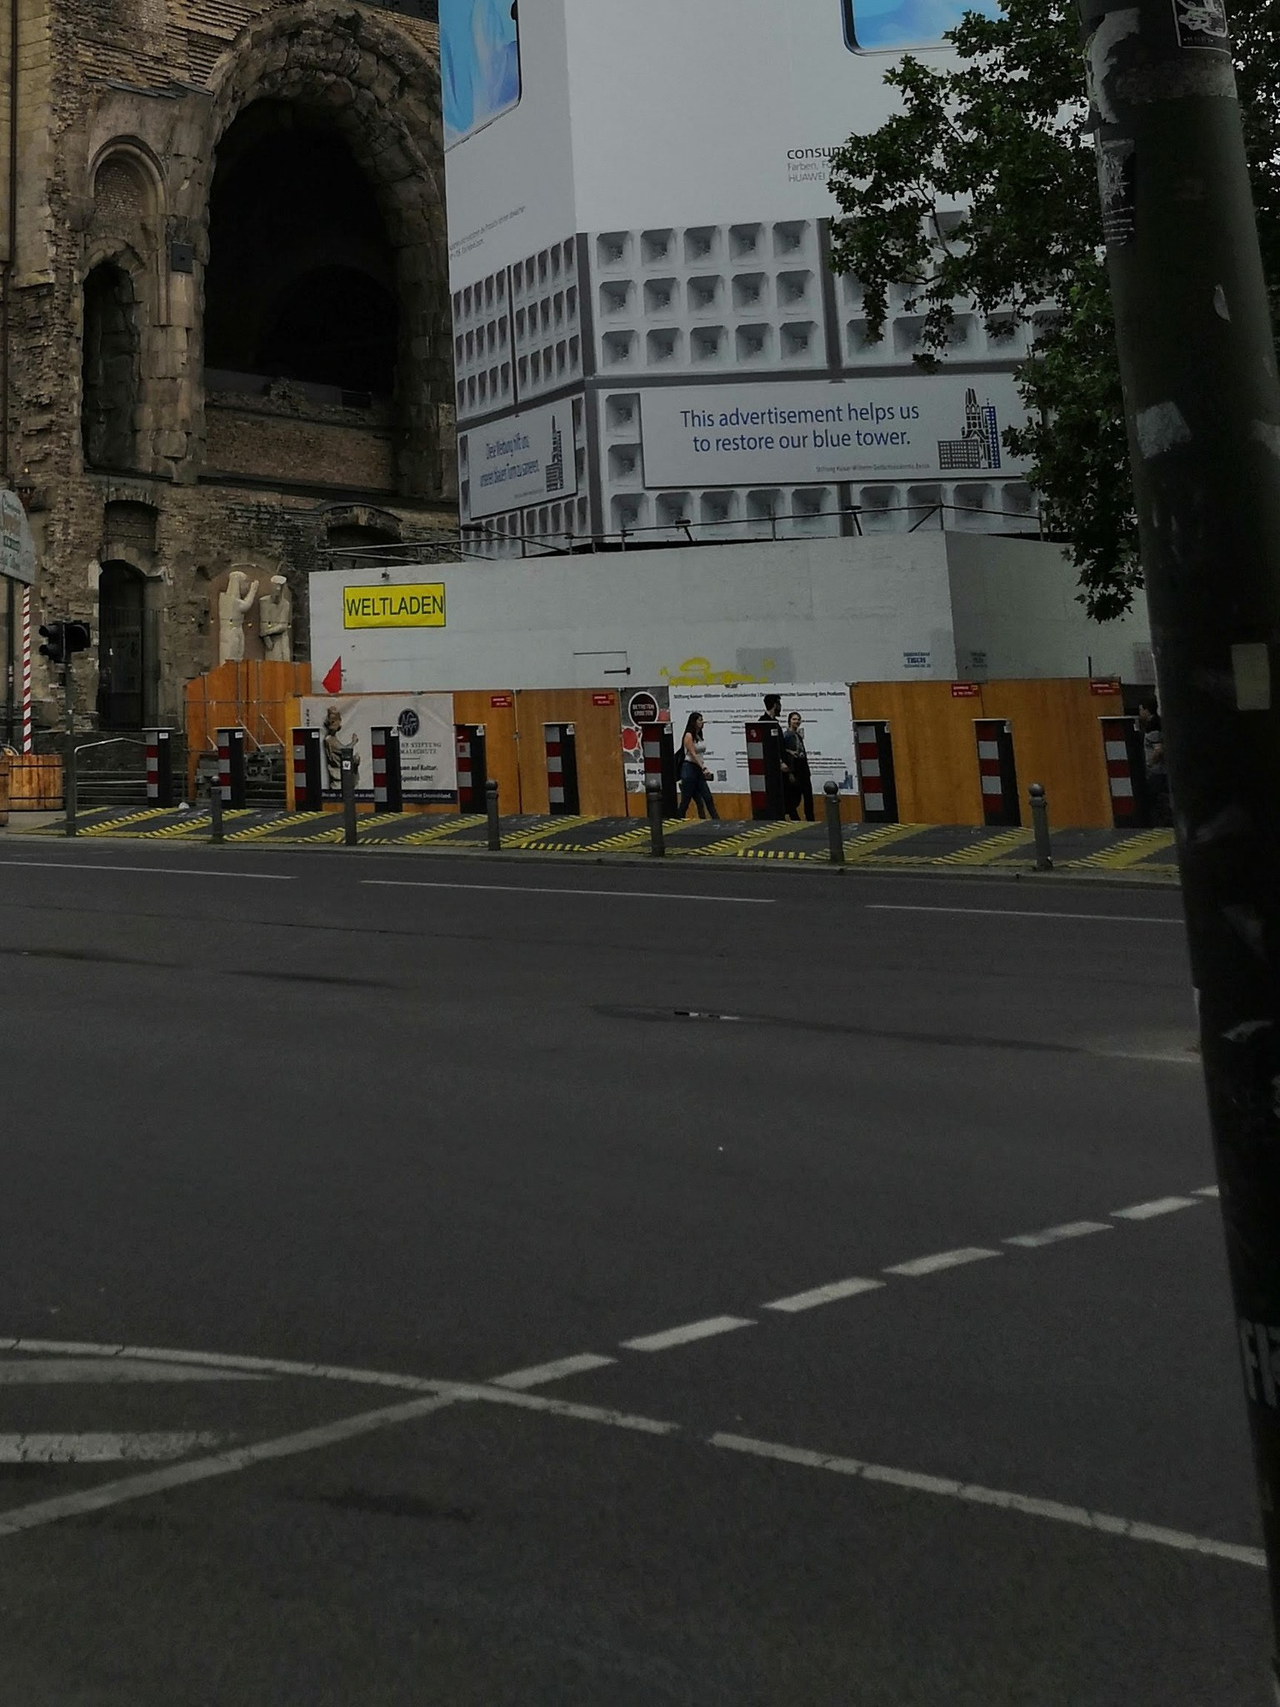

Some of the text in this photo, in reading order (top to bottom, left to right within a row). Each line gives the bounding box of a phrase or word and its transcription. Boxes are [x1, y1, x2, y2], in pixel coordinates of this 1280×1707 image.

[680, 402, 920, 428] This advertisement helps us
[693, 429, 911, 452] to restore our blue tower.
[346, 595, 445, 616] WELTLADEN
